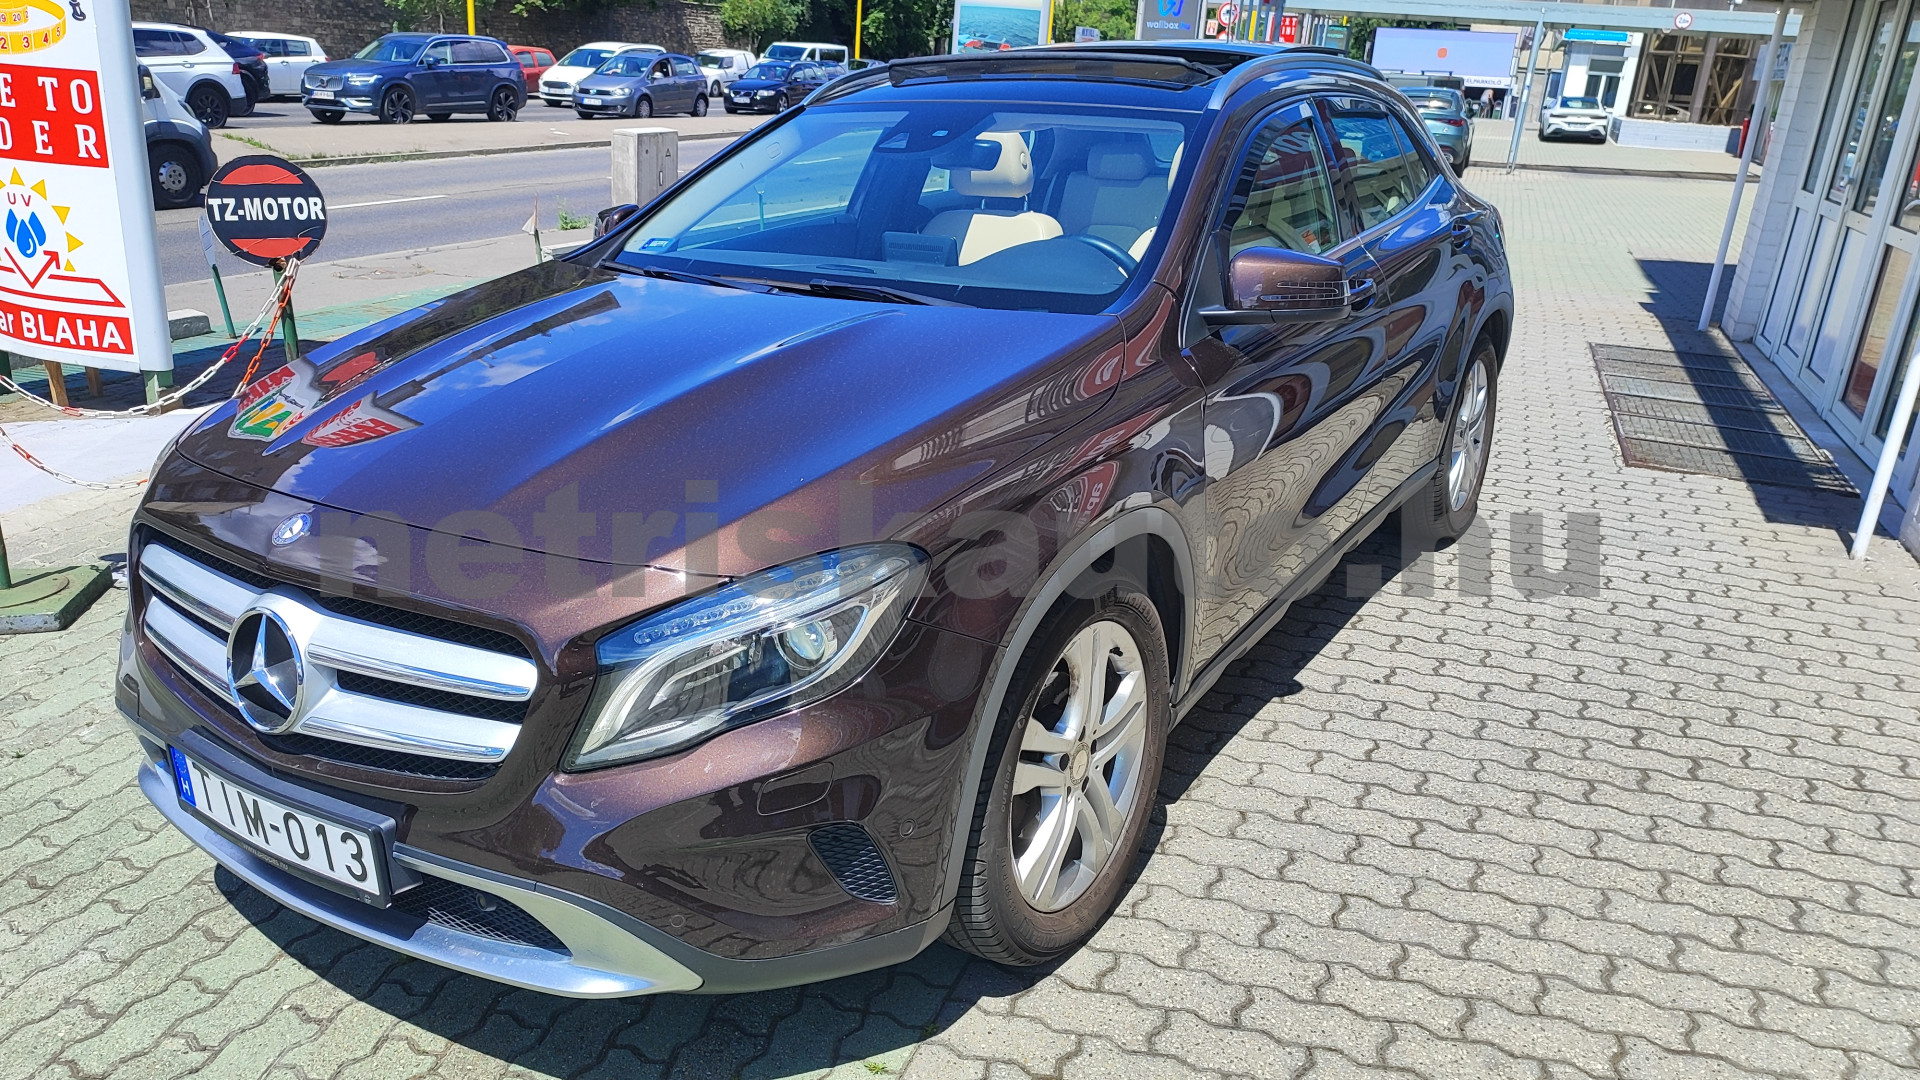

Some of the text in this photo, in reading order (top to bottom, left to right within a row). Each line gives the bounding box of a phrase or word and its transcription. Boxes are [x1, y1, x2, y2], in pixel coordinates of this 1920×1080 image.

[22, 36, 30, 48] 3
[42, 32, 49, 44] 4
[56, 27, 61, 37] 5
[37, 76, 93, 115] TO
[207, 196, 326, 222] TZ-MOTOR
[20, 310, 127, 350] BLAHA
[180, 779, 191, 797] H
[1001, 763, 1013, 813] OUTSIDE
[193, 762, 369, 883] TIM-013
